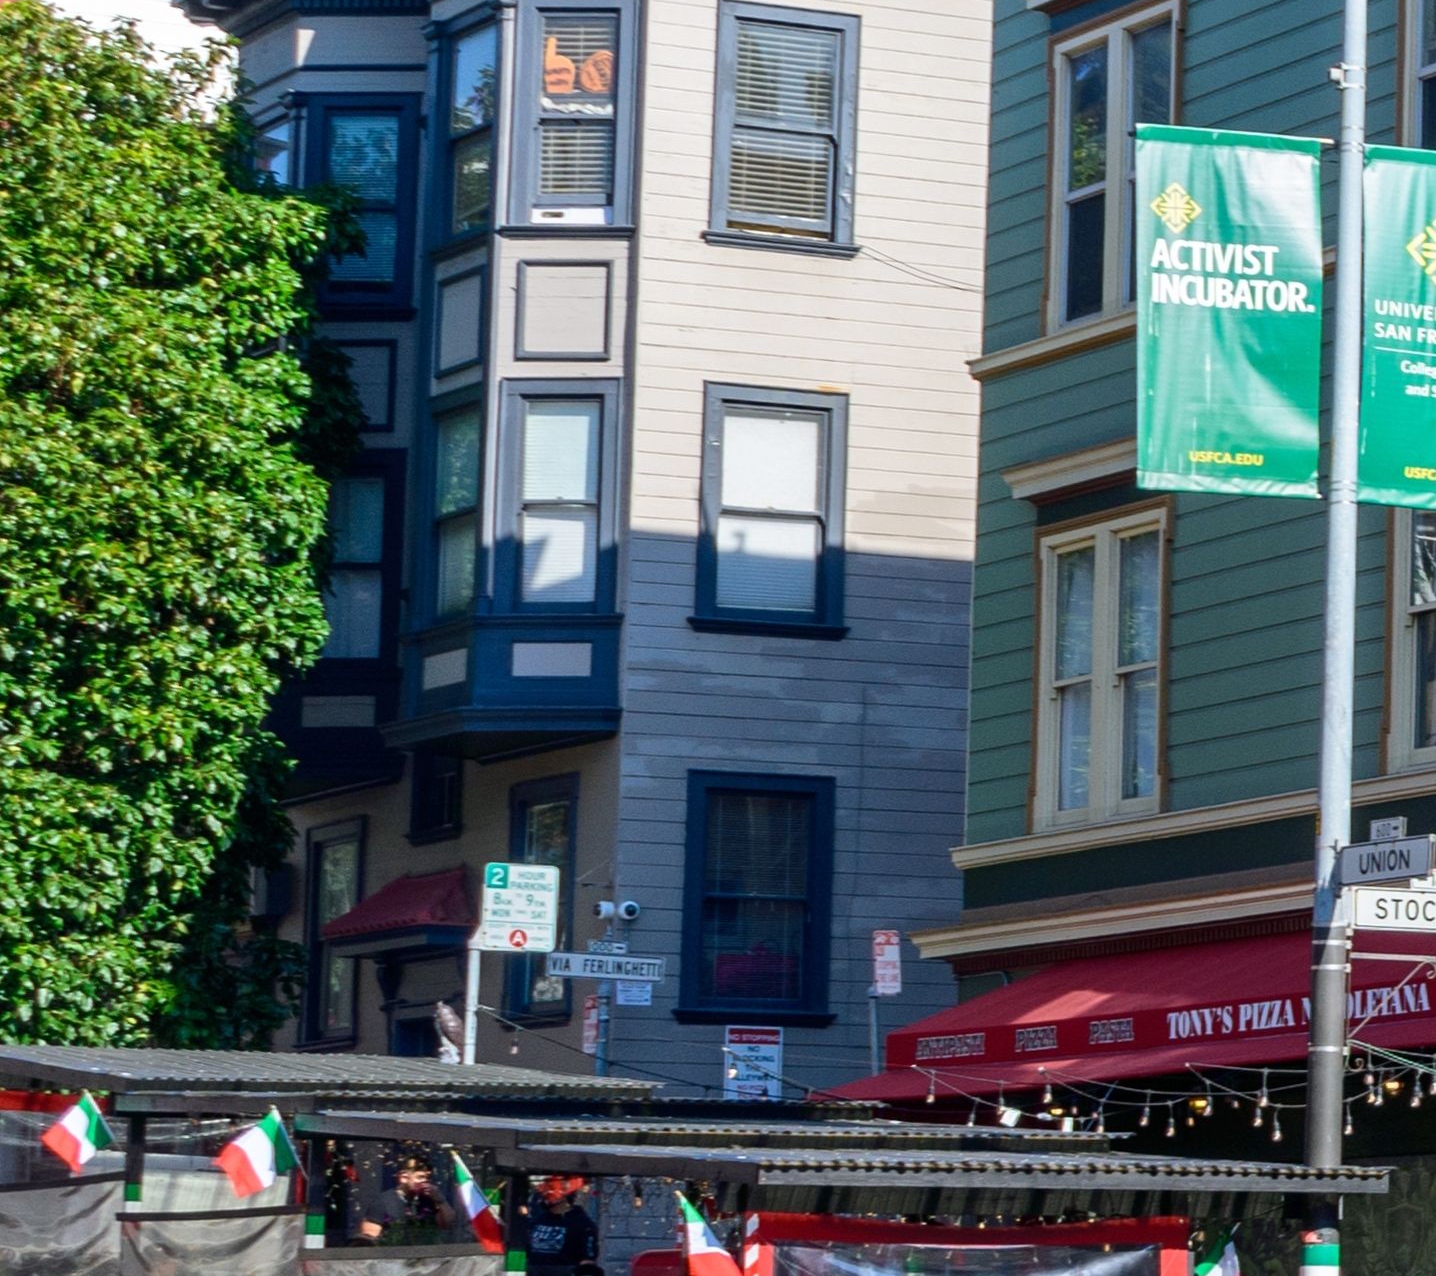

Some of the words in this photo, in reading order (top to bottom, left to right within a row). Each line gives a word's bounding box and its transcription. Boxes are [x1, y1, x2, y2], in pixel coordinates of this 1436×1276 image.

[1151, 239, 1278, 276] ACTIVIST
[1151, 273, 1315, 312] INCUBATOR.
[1374, 323, 1411, 342] SAN
[1405, 384, 1429, 397] and
[1188, 450, 1263, 467] USFCA.EDU
[1360, 849, 1410, 874] UNION
[491, 868, 504, 885] 2
[512, 932, 525, 943] A
[551, 957, 571, 972] VIA
[1167, 1005, 1233, 1040] TONY'S
[1238, 998, 1295, 1032] PIZZA
[1301, 982, 1430, 1026] NOLETANA
